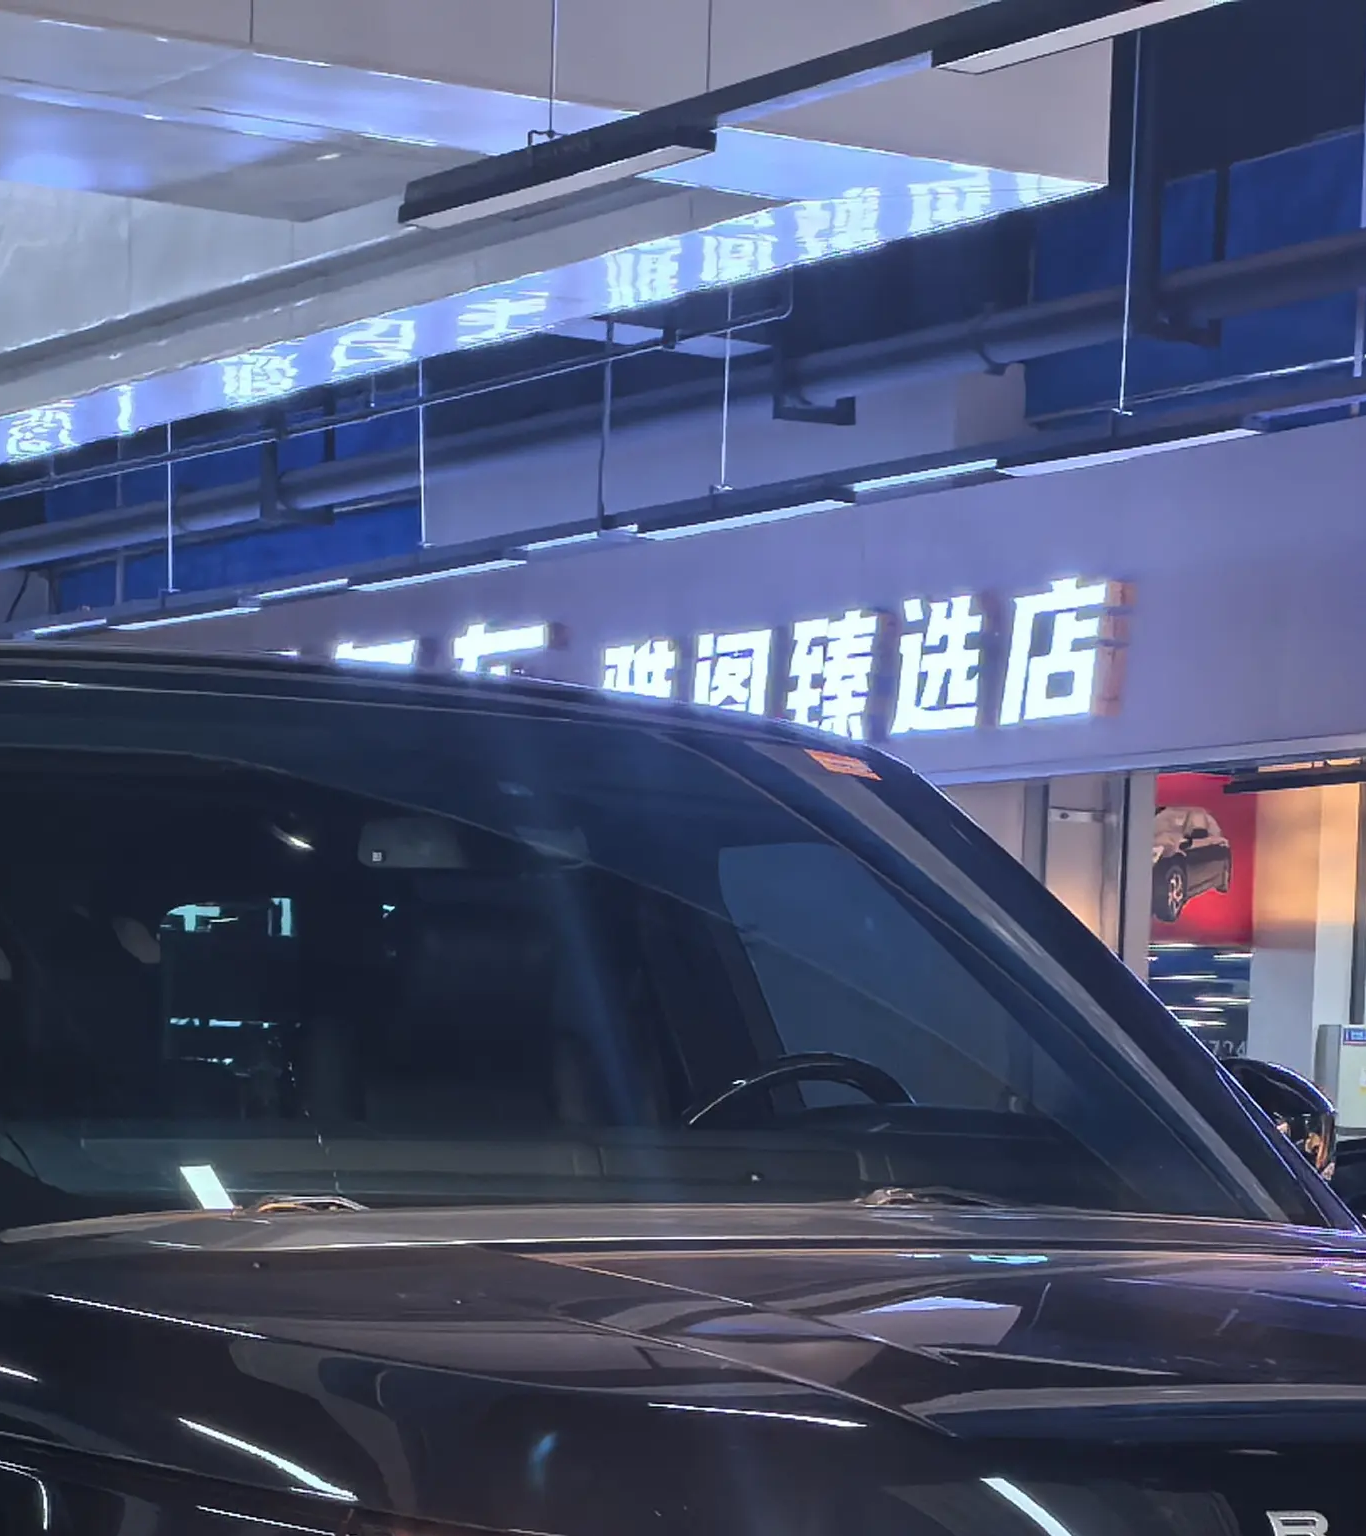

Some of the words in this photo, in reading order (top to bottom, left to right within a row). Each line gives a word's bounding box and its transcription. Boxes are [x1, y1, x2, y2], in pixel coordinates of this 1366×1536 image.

[601, 575, 1109, 742] 雅阁臻选店
